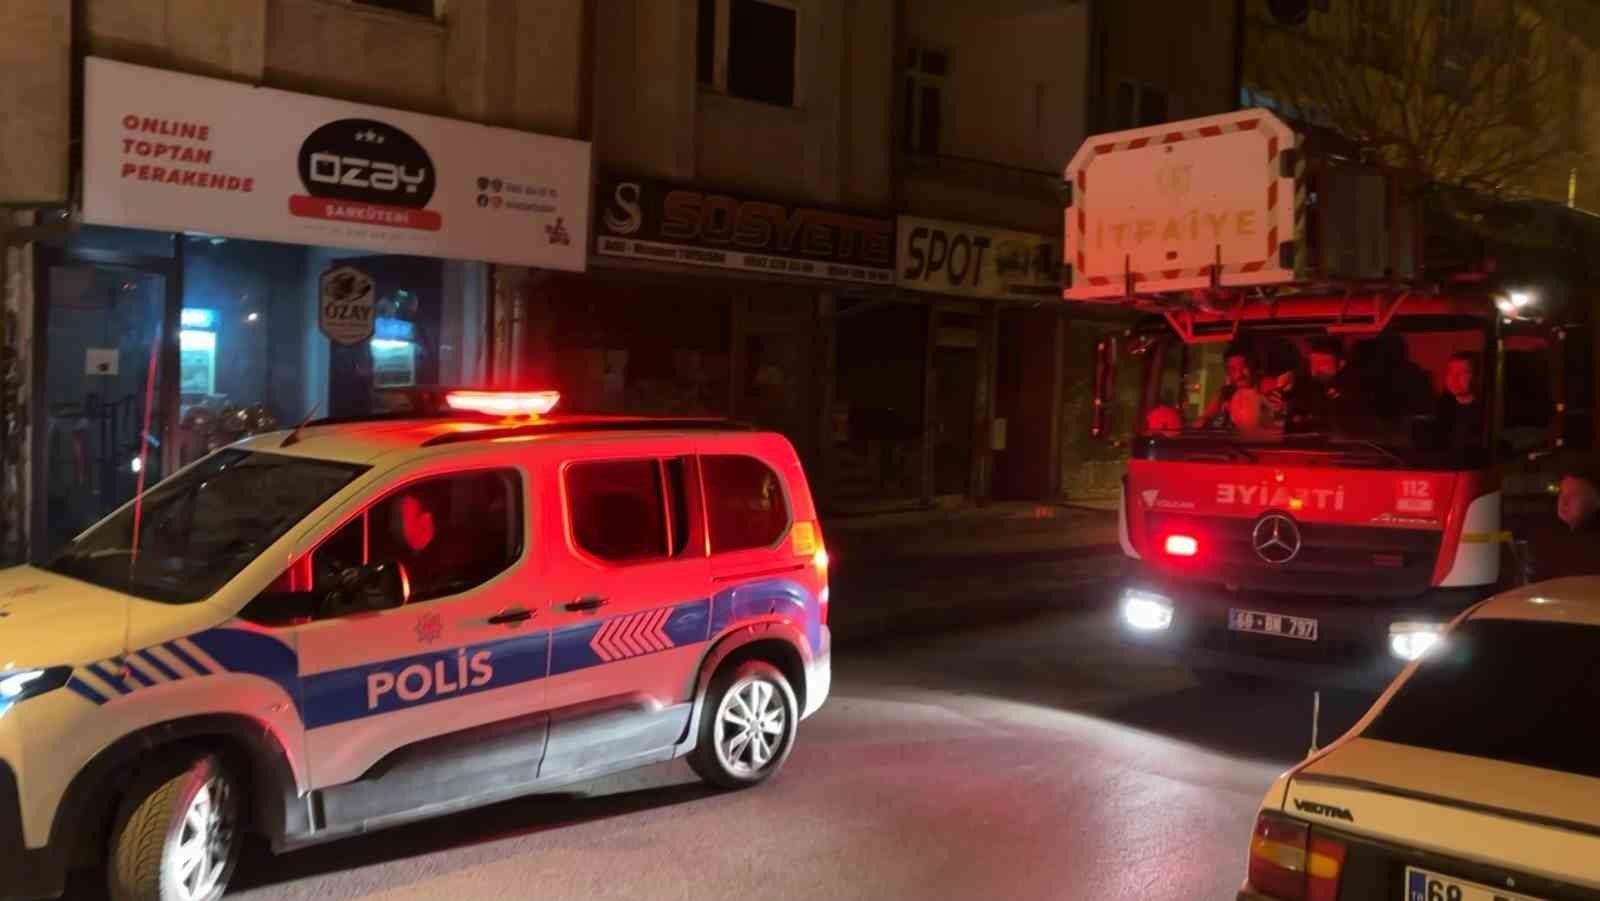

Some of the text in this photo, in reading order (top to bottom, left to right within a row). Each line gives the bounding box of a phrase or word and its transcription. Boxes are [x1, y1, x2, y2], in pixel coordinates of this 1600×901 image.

[122, 114, 209, 141] ONLINE
[122, 138, 212, 164] TOPTAN
[120, 162, 255, 192] PERAKENDE
[659, 189, 892, 267] SOSYETE
[903, 227, 993, 288] SPOT
[1402, 480, 1430, 497] 112
[367, 647, 494, 710] POLİS
